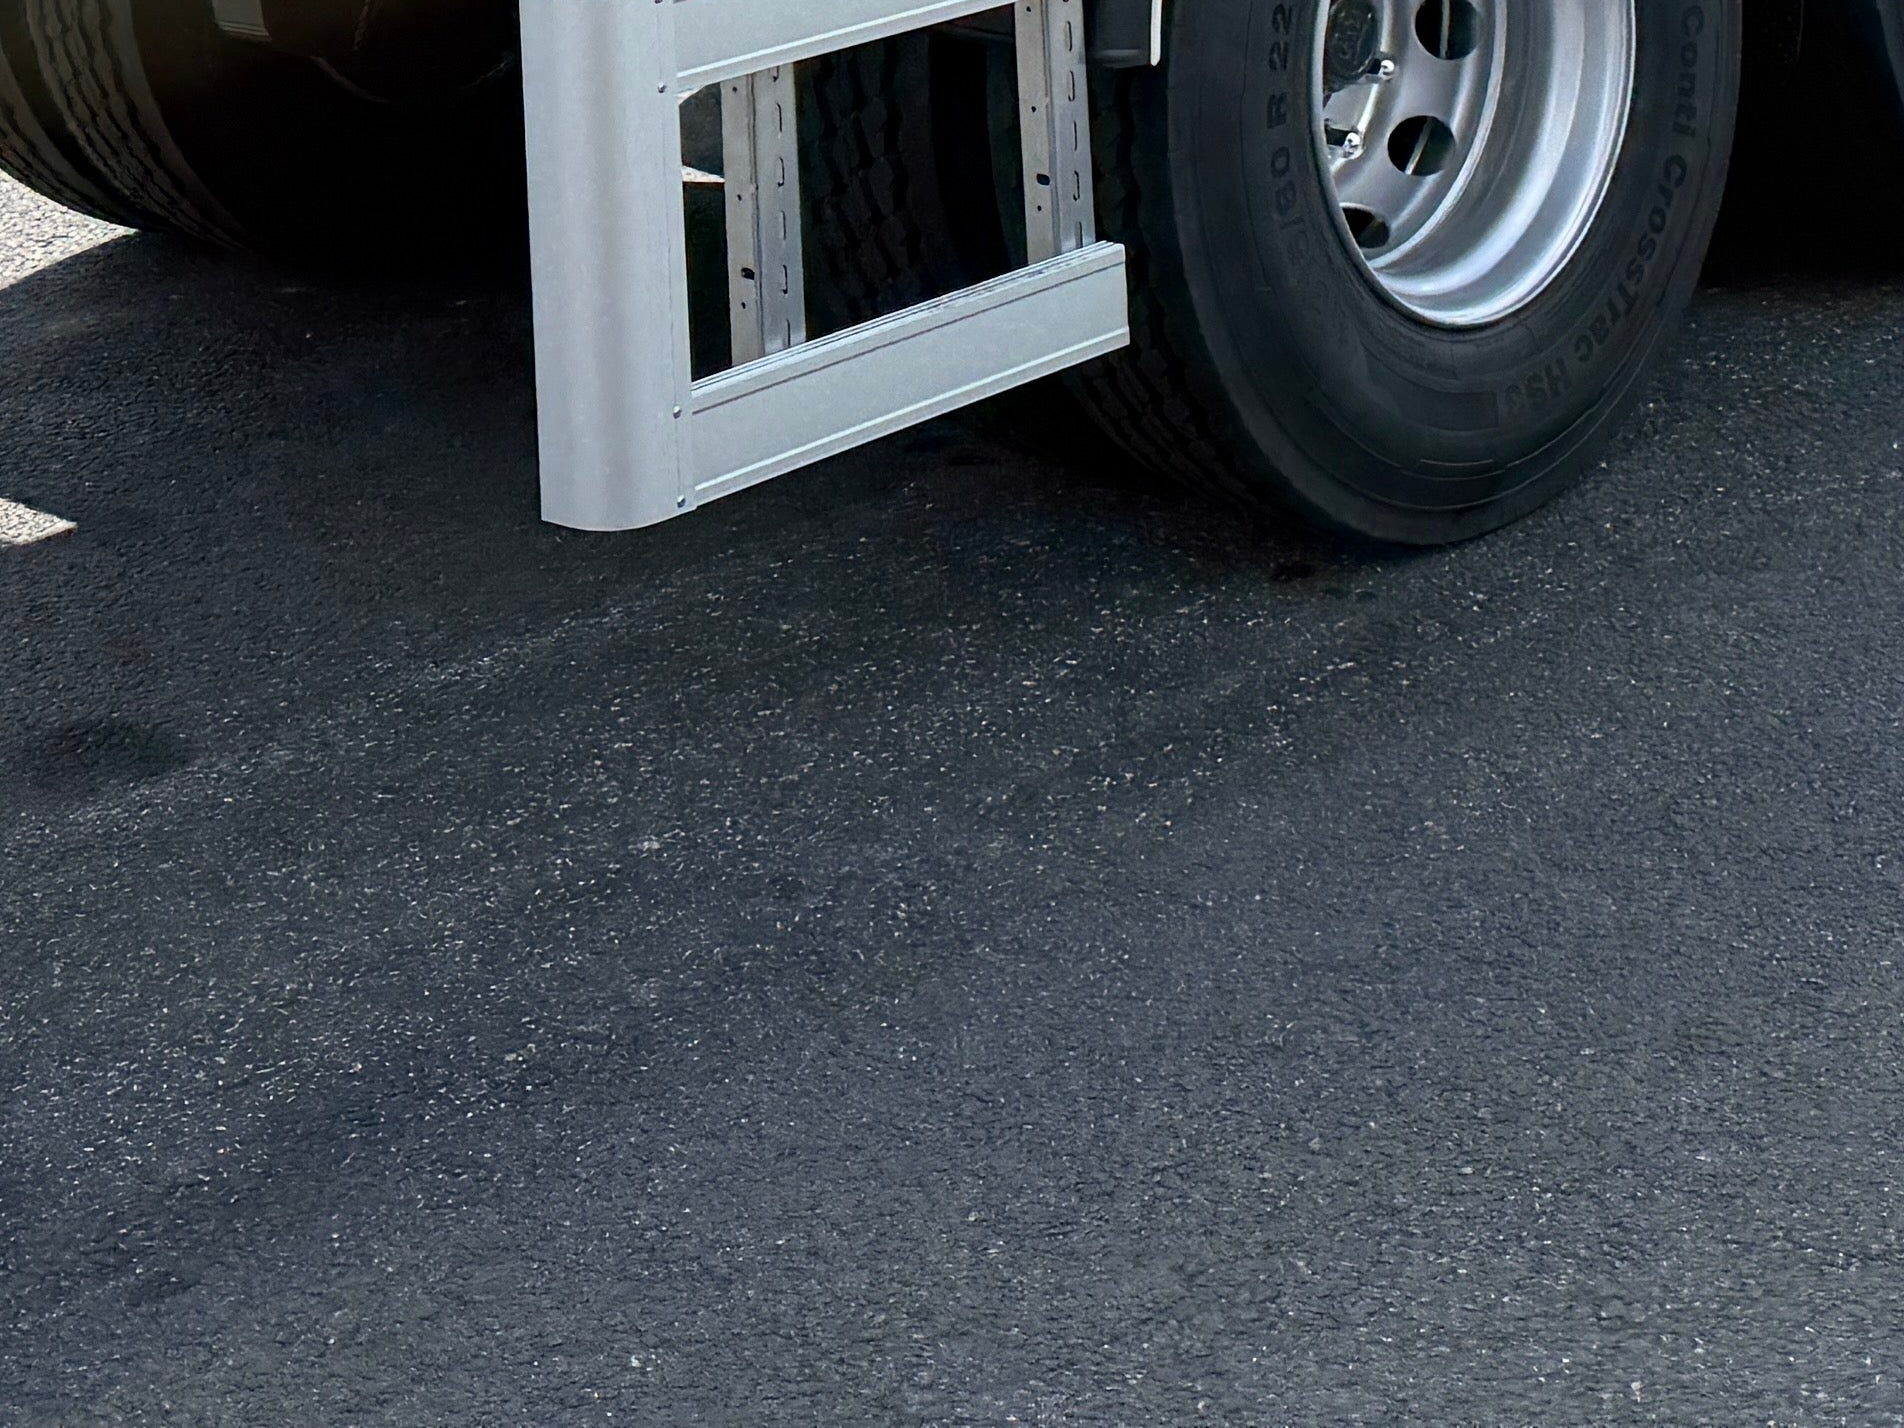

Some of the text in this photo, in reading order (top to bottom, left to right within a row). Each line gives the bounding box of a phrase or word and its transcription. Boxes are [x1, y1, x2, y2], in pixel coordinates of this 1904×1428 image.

[1266, 92, 1288, 130] R
[1671, 4, 1705, 139] Conti
[1574, 153, 1688, 364] CrossTrac
